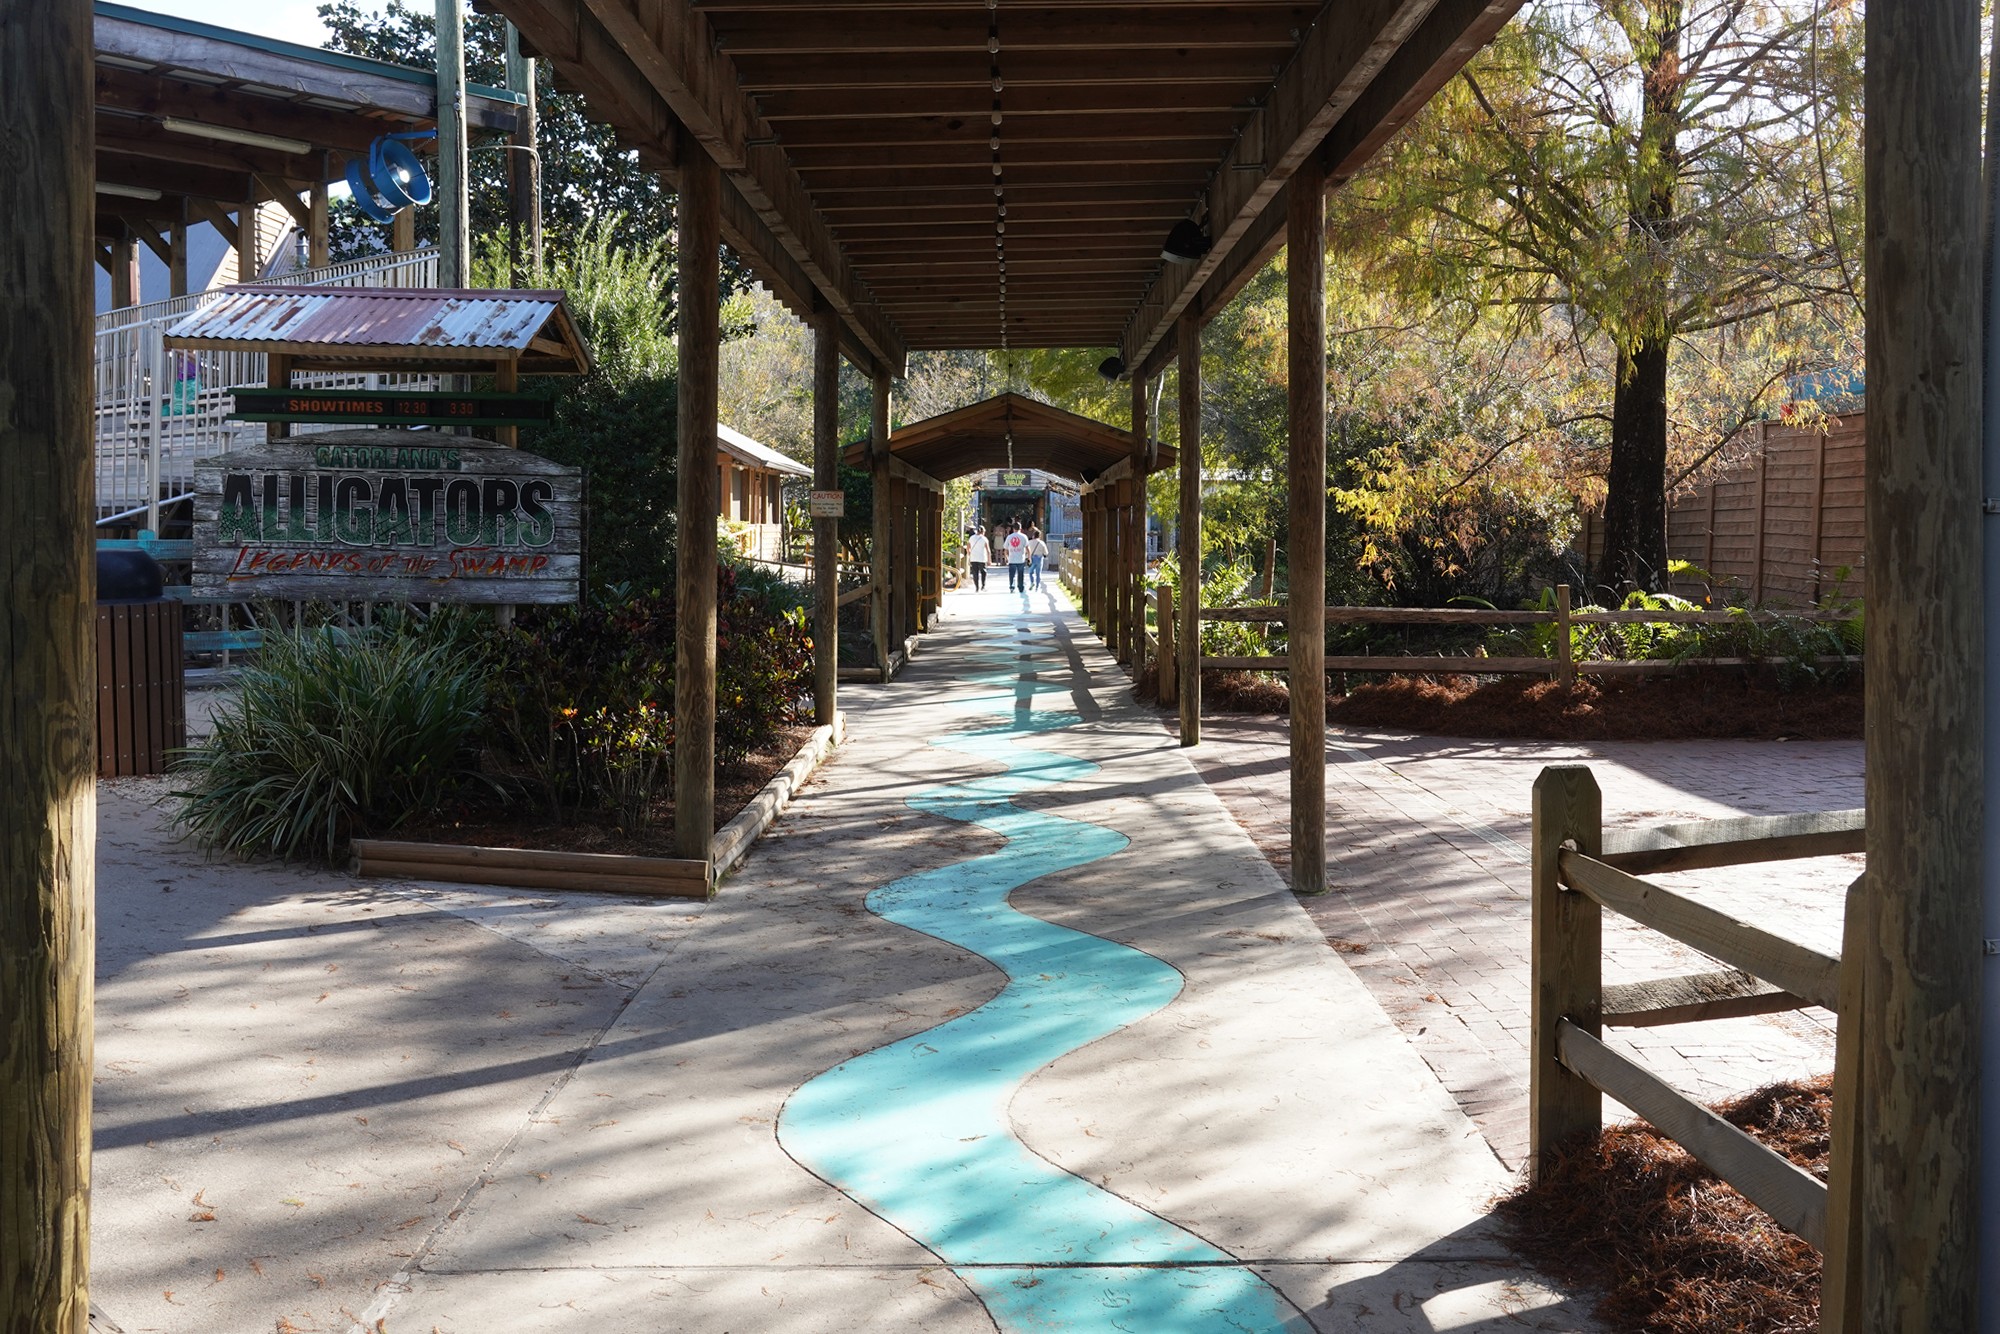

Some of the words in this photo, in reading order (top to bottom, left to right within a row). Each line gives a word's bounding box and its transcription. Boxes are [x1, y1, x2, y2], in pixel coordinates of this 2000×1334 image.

[289, 400, 384, 413] SHOWTIMES
[315, 446, 462, 471] GATORLAND'S
[218, 474, 556, 548] ALLIGATORS
[226, 546, 362, 584] LEGENDS
[367, 553, 399, 572] OF
[402, 554, 439, 574] THE
[430, 547, 549, 583] SWAMP
